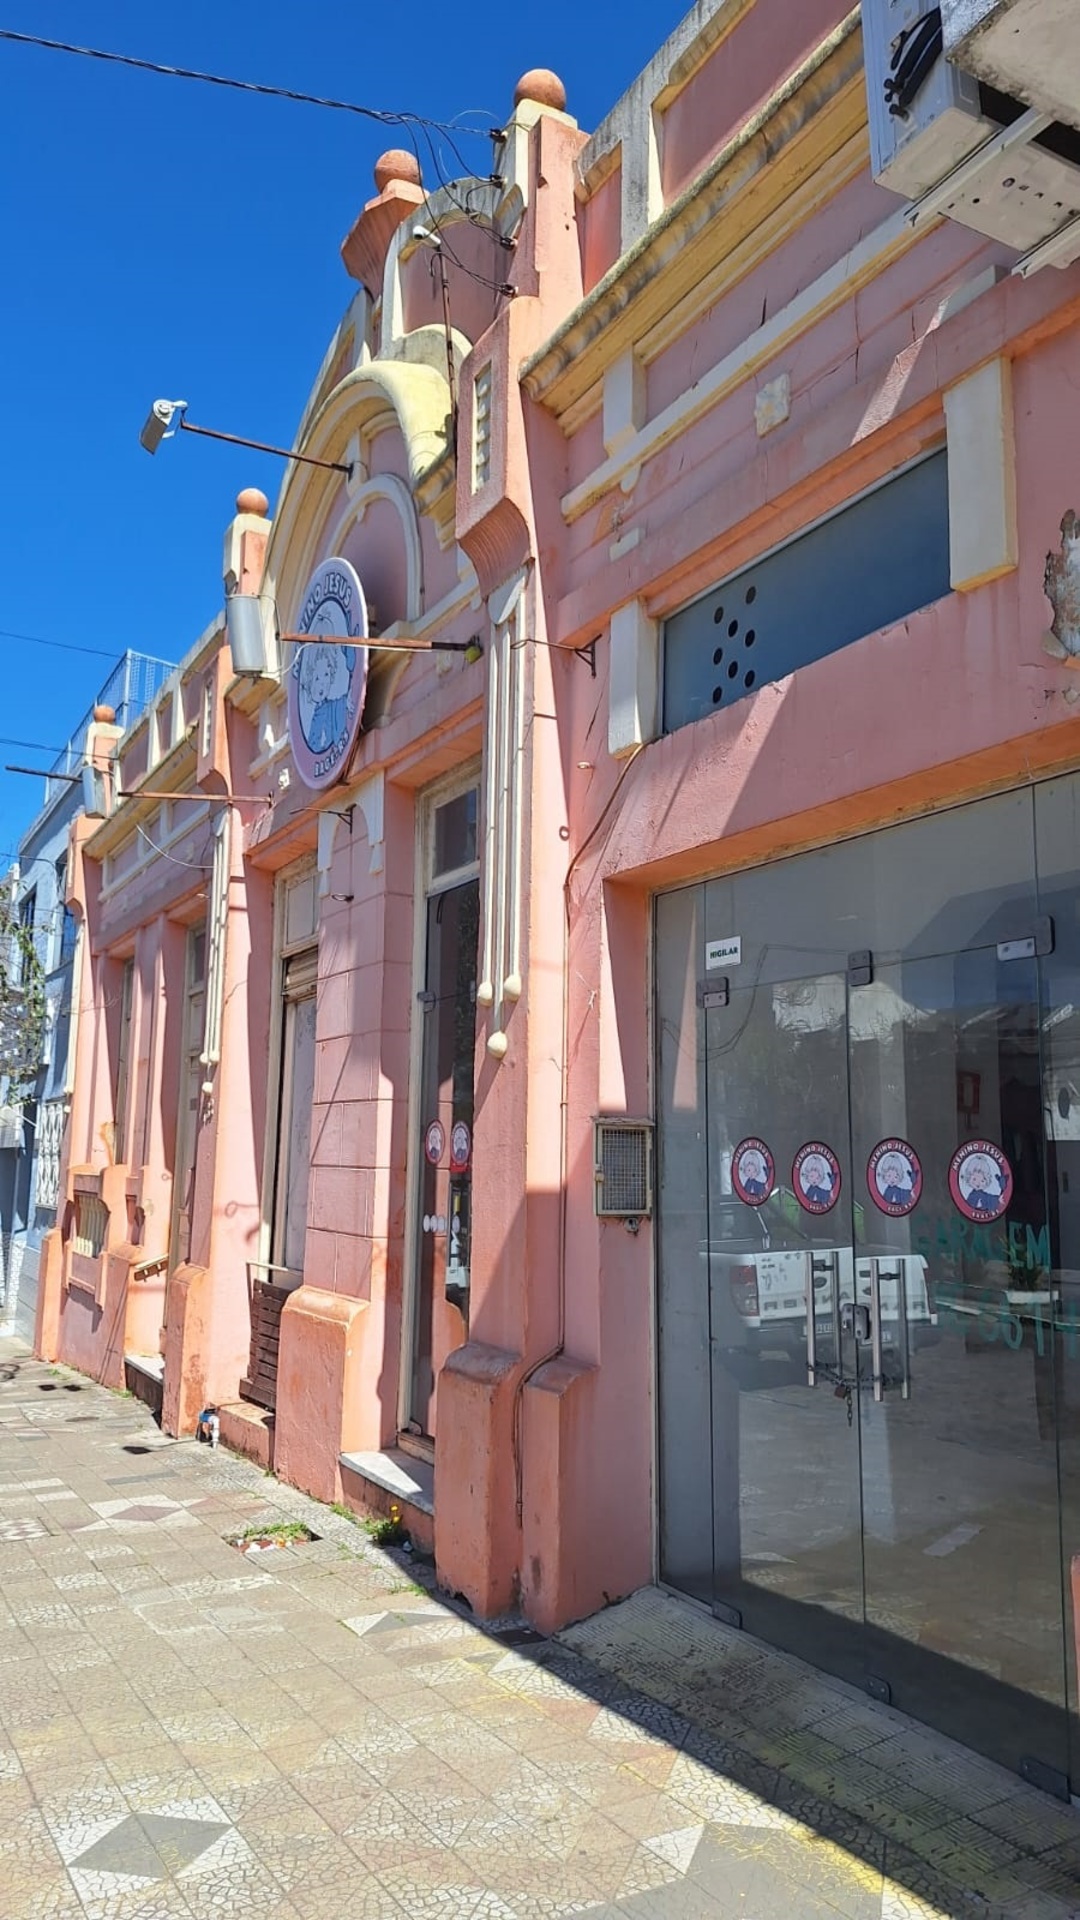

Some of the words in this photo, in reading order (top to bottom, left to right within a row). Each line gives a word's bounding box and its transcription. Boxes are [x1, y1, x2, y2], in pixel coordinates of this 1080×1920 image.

[324, 571, 353, 608] JESUS
[870, 1143, 893, 1168] MENINO
[952, 1143, 979, 1171] MENINO
[982, 1144, 1005, 1164] JESUS
